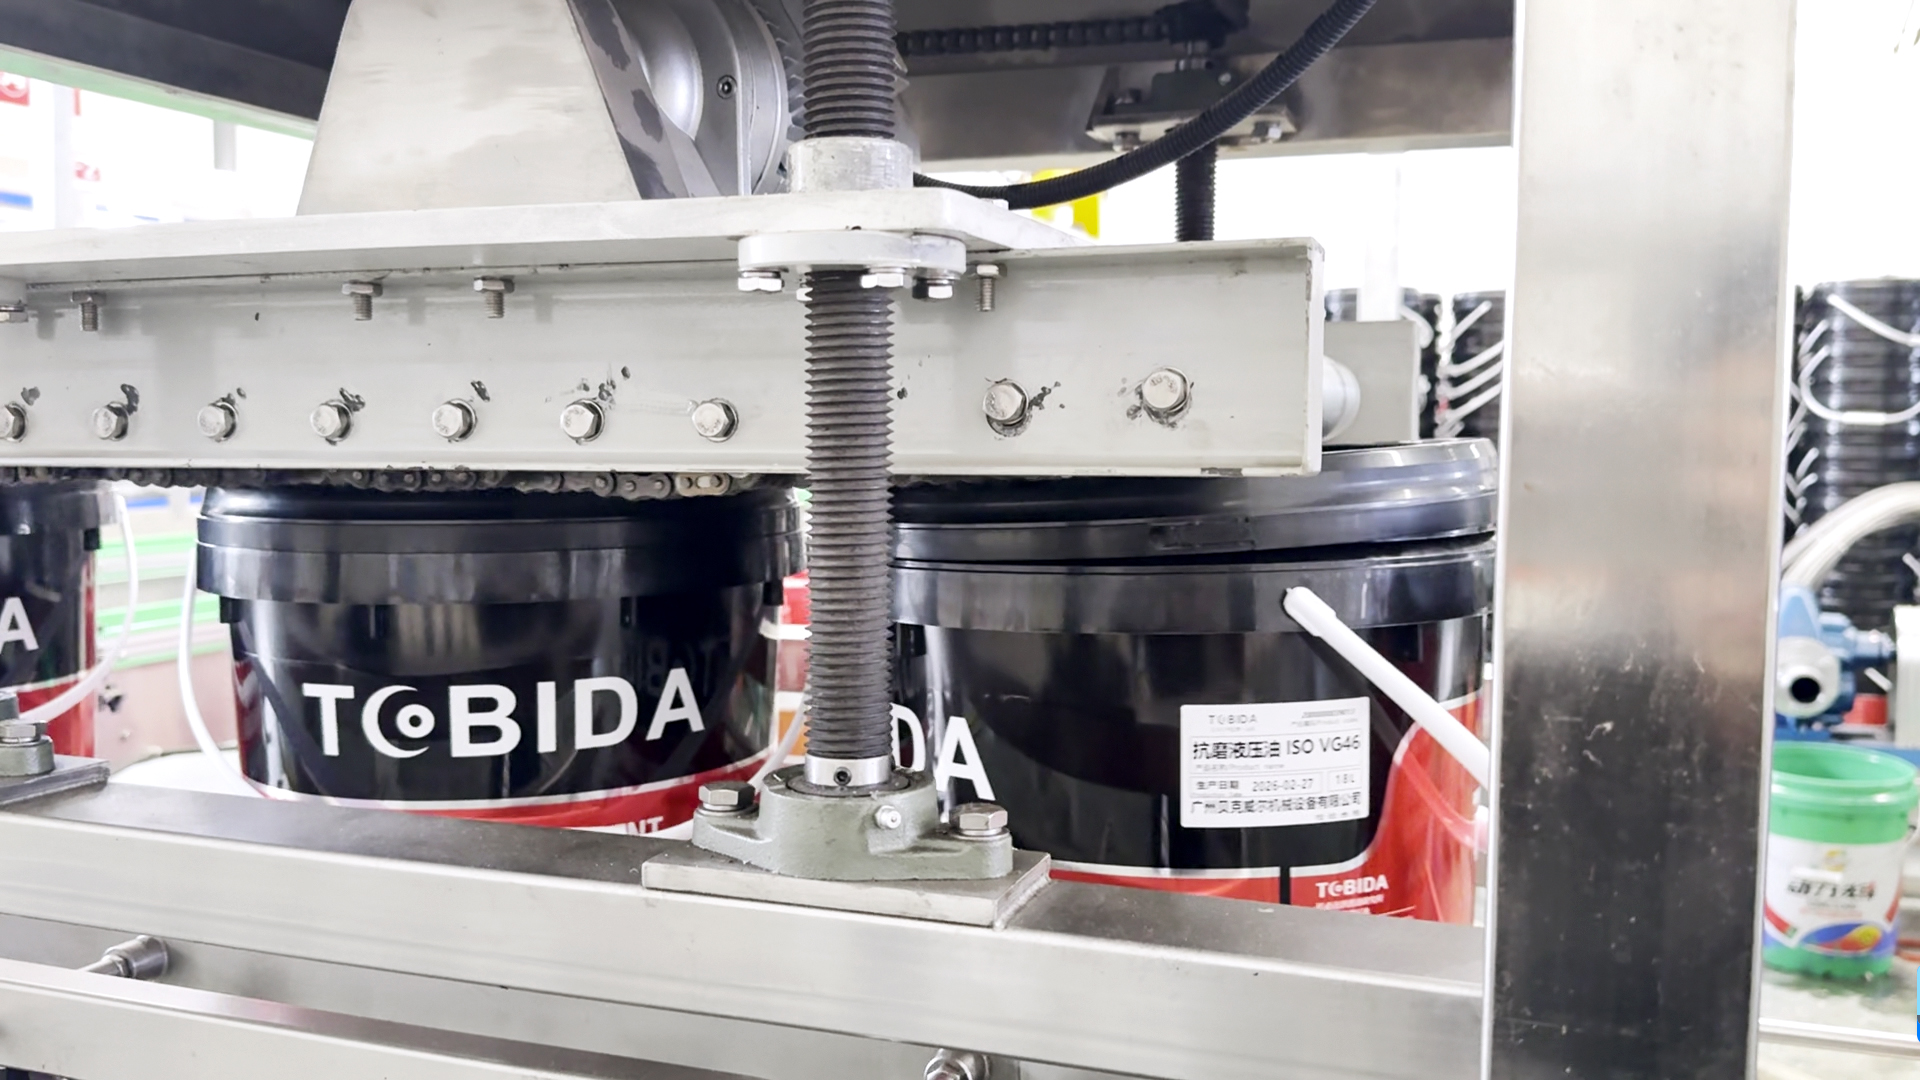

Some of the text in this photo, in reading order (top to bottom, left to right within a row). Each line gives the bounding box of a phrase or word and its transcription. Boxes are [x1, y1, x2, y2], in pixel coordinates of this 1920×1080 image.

[302, 667, 705, 759] TOBIDA
[1208, 714, 1258, 725] TOBIDA
[1193, 734, 1361, 760] 抗磨液压油 ISO VG46
[1196, 778, 1314, 792] 生产日期 2026-02-27
[1315, 874, 1389, 898] TOBIDA
